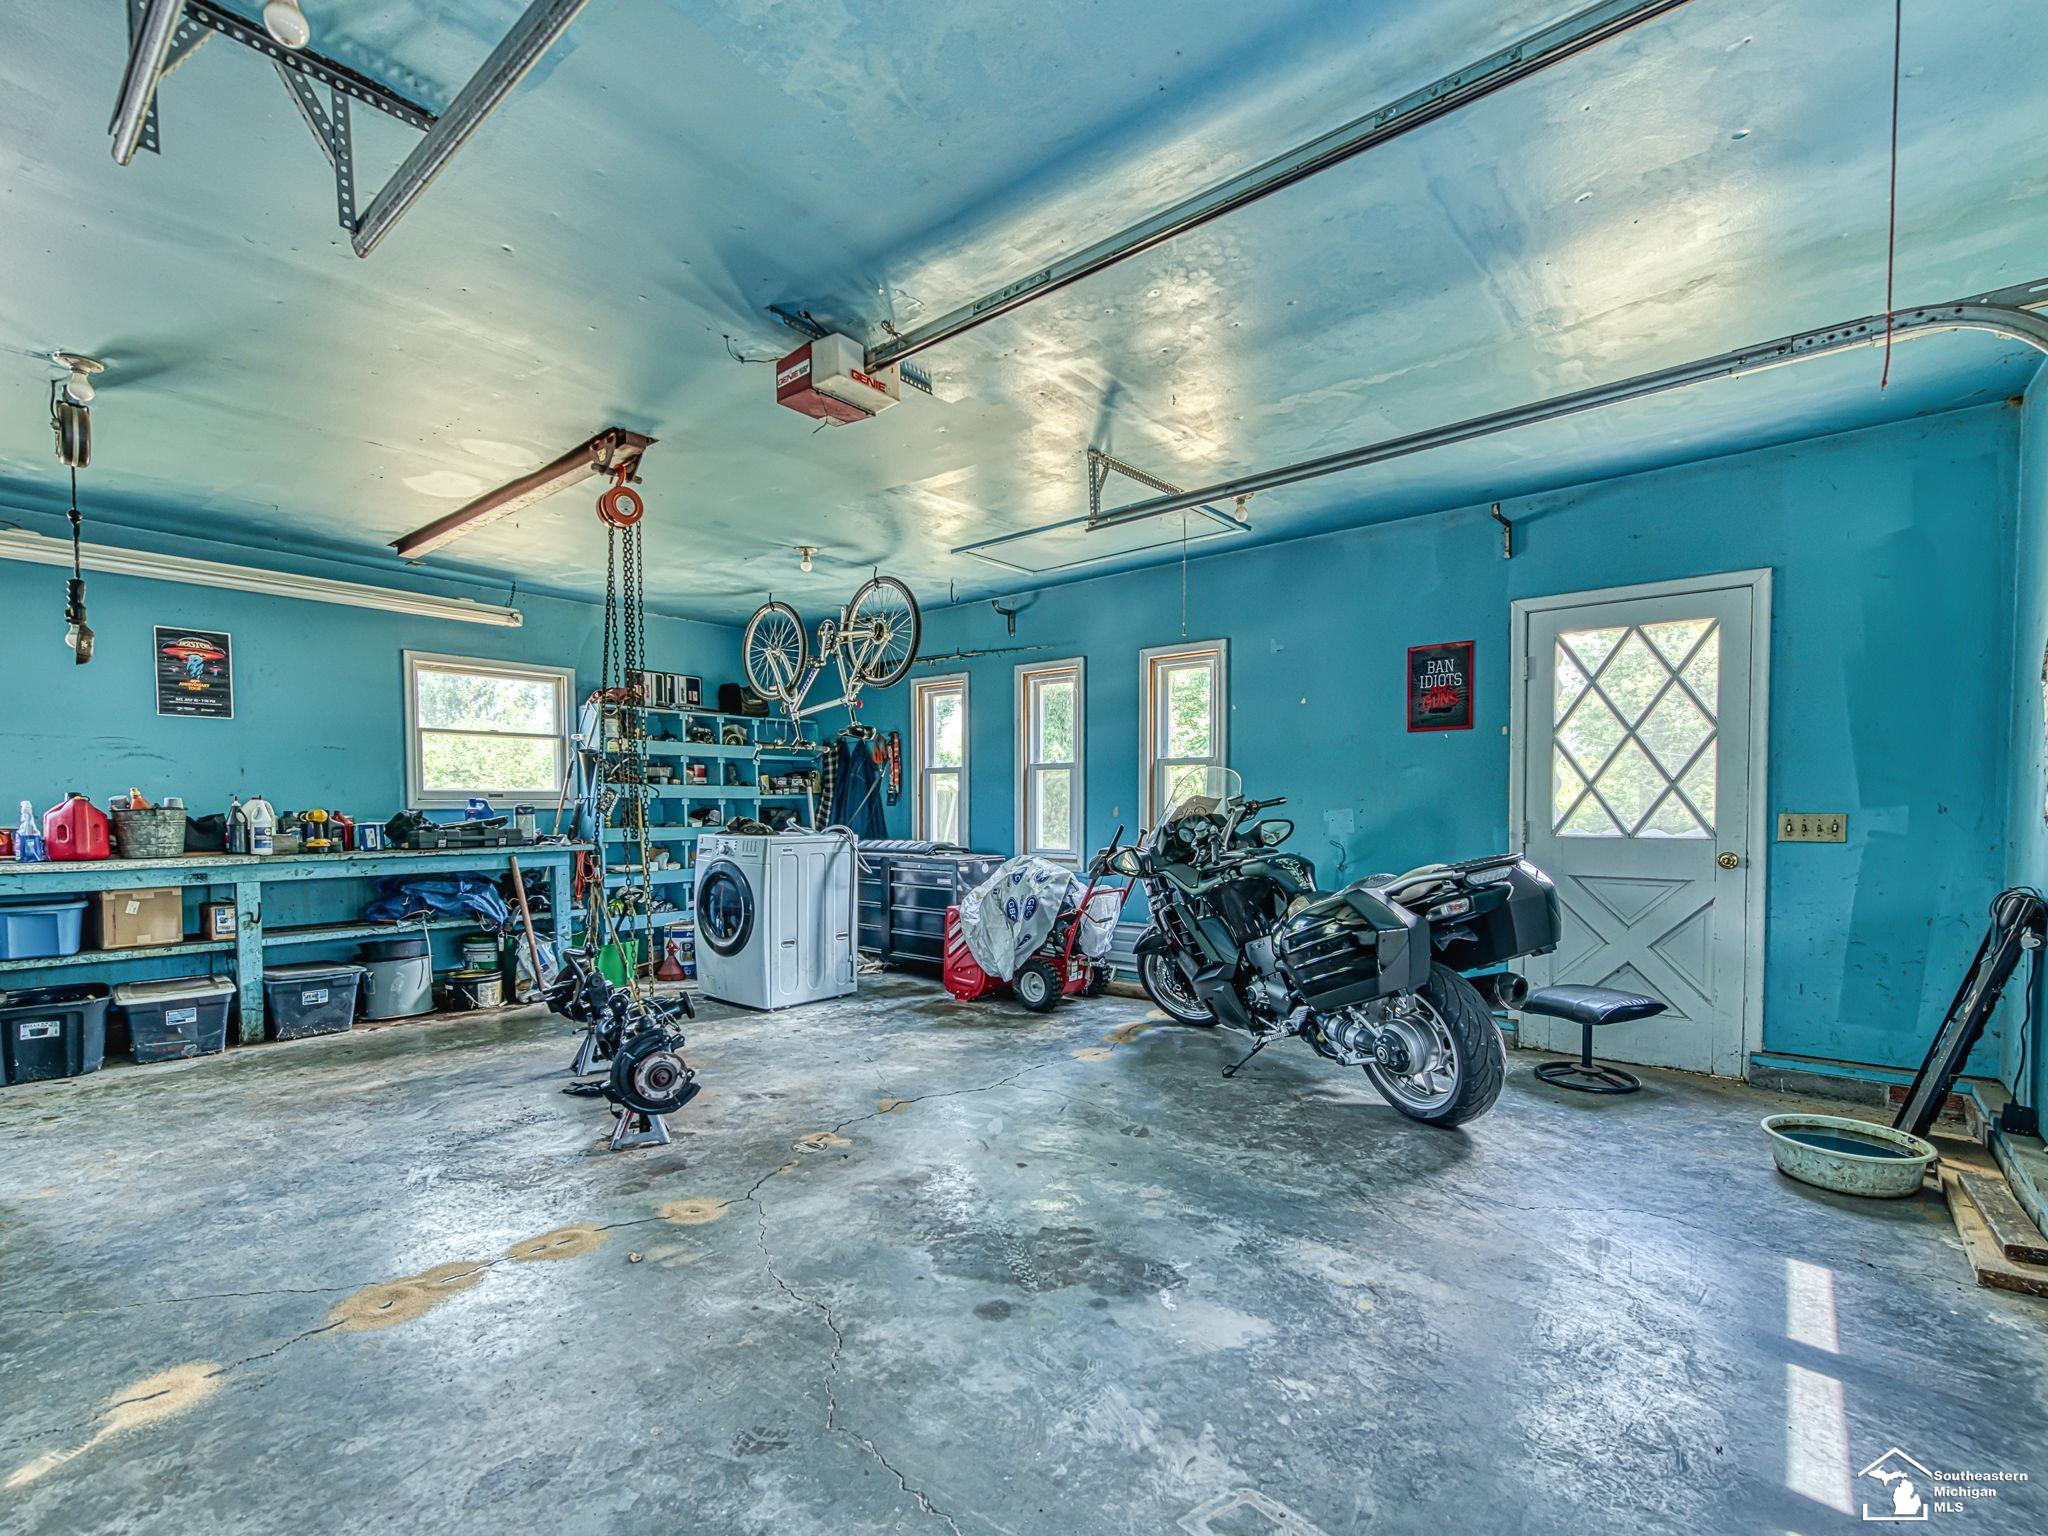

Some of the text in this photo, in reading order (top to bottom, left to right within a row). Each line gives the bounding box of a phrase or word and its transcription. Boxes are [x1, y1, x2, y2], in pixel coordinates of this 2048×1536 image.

[851, 370, 887, 392] GENIE
[178, 640, 214, 650] BOSTON
[1427, 659, 1455, 674] BAN
[1420, 672, 1463, 689] IDIOTS
[1025, 898, 1035, 917] GBC
